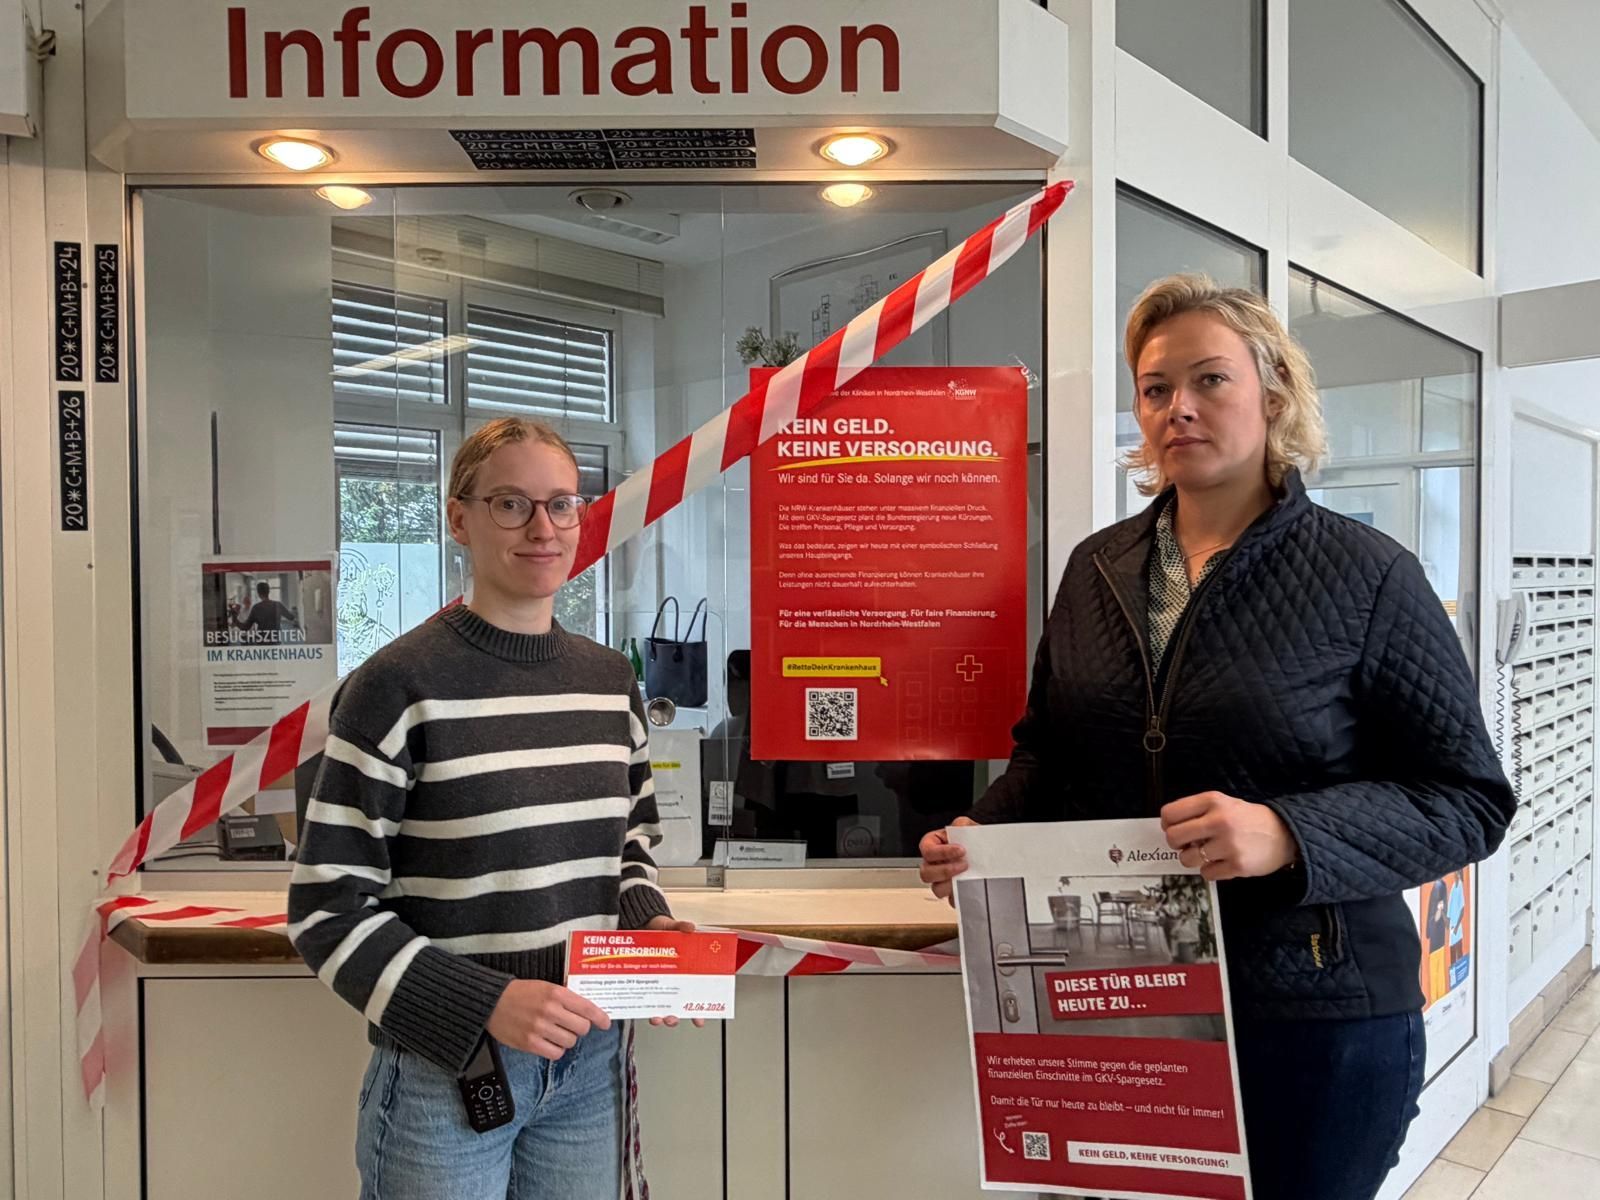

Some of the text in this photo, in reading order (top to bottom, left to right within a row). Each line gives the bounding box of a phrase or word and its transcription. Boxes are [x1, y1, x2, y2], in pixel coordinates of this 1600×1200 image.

[228, 3, 900, 98] Information
[955, 388, 976, 396] KGNW
[778, 419, 894, 434] KEIN GELD.
[778, 441, 998, 457] KEINE VERSORGUNG.
[778, 473, 1000, 485] Wir sind für Sie da. Solange wir noch können.
[862, 610, 909, 618] Versorgung.
[946, 609, 997, 617] Finanzierung.
[207, 630, 306, 643] BESUCHSZEITEN
[208, 648, 322, 661] IM KRANKENHAUS
[1127, 848, 1178, 861] Alexian
[584, 936, 635, 944] KEIN GELD.
[583, 947, 678, 956] KEINE VERSORGUNG.
[1055, 973, 1186, 992] DIESE TÜR BLEIBT
[683, 1003, 725, 1011] 12.06.2026
[1058, 997, 1146, 1012] HEUTE ZU...
[987, 1056, 1000, 1064] Wir
[1004, 1057, 1035, 1066] erheben
[1067, 1059, 1097, 1069] Stimme
[1100, 1063, 1126, 1072] gegen
[1129, 1061, 1142, 1070] die
[1144, 1063, 1187, 1073] geplanten
[988, 1069, 1165, 1087] finanziellen Einschnitte im GKV-Spargesetz.
[991, 1096, 1014, 1105] Damit
[1017, 1097, 1028, 1106] die
[1031, 1097, 1043, 1106] Tür
[1062, 1099, 1085, 1109] heute
[1087, 1102, 1097, 1110] zu
[1100, 1101, 1124, 1111] bleibt
[1135, 1104, 1151, 1112] und
[1154, 1104, 1175, 1114] nicht
[1178, 1106, 1190, 1116] für
[1192, 1106, 1224, 1118] immer!
[1079, 1149, 1229, 1168] KEIN GELD, KEINE VERSORGUNG!
